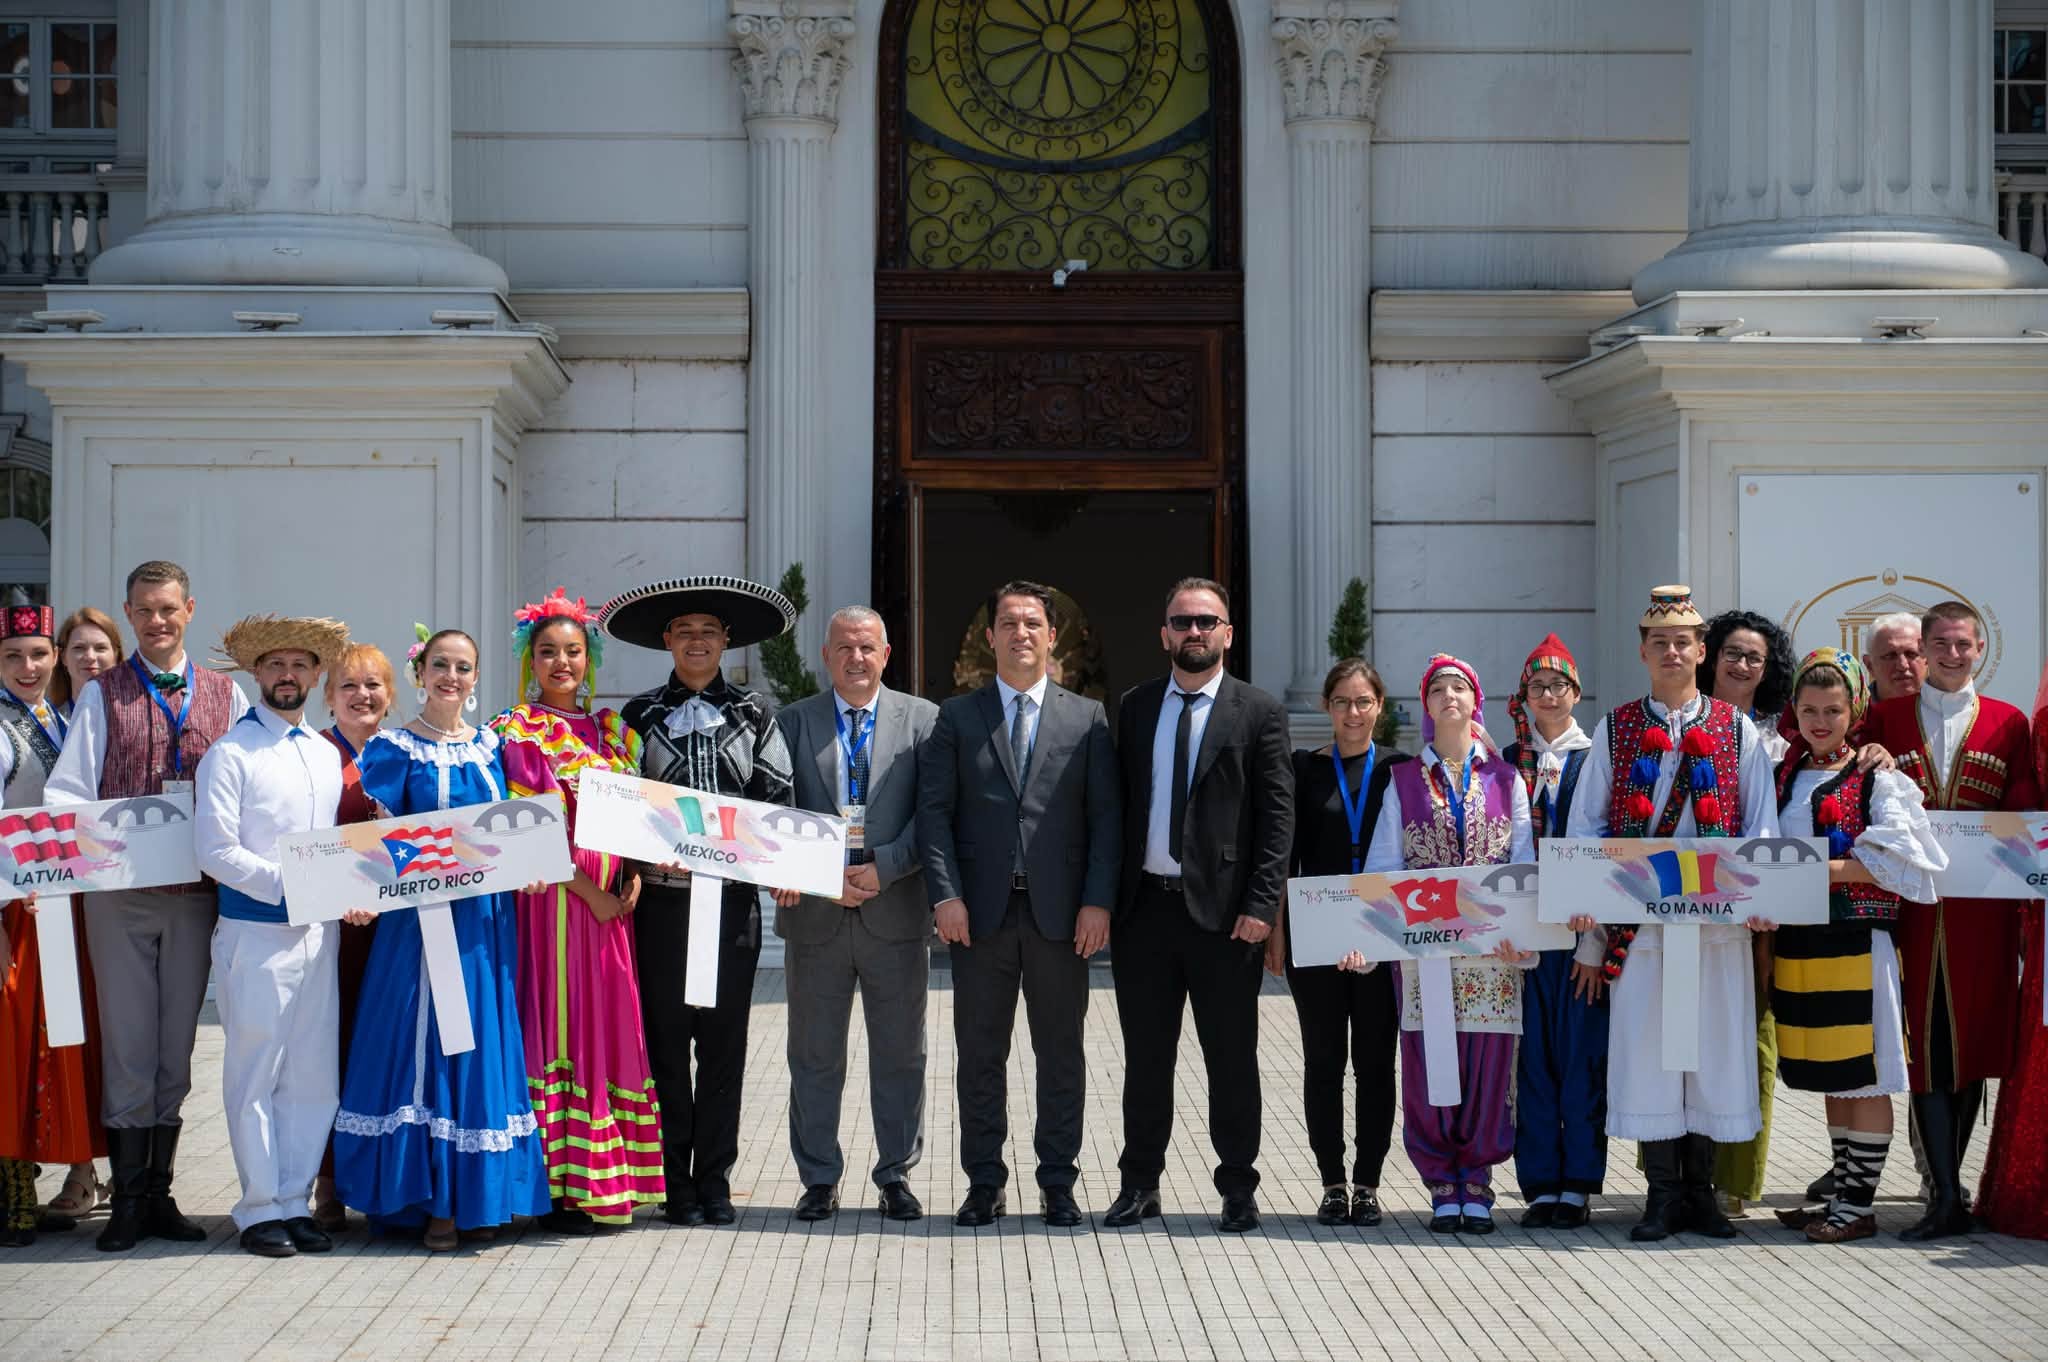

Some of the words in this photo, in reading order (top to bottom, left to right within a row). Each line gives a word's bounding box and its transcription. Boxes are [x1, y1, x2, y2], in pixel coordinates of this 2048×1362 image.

[673, 842, 738, 864] MEXICO
[13, 867, 75, 886] LATVIA
[379, 877, 441, 900] PUERTO
[445, 870, 485, 889] RICO
[1646, 902, 1734, 915] ROMANIA
[1402, 928, 1464, 945] TURKEY
